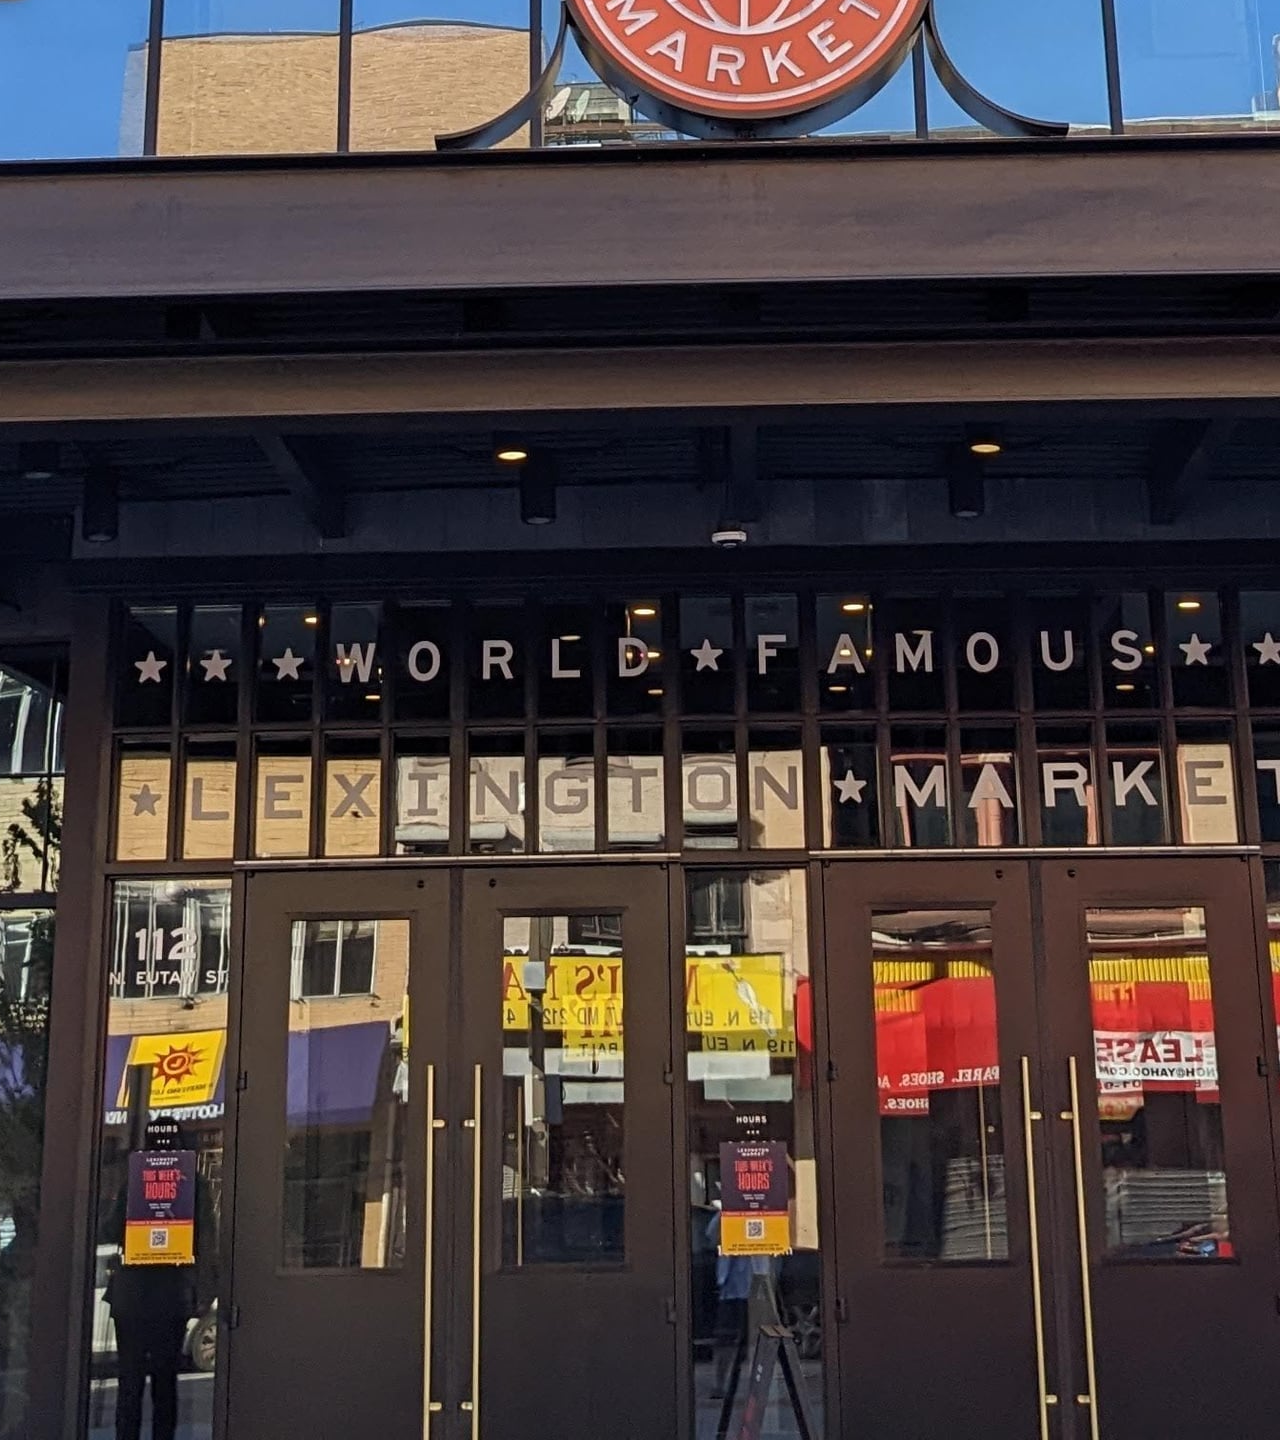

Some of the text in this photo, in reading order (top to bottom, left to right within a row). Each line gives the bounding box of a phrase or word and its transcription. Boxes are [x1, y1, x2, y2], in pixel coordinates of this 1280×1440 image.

[336, 630, 1143, 684] WORLD FAMOUS
[191, 764, 798, 821] LEXINGTON
[135, 927, 197, 960] 112
[109, 971, 126, 985] N.
[136, 970, 197, 985] EUTAW
[736, 1115, 767, 1124] HOURS
[147, 1125, 178, 1133] HOURS
[738, 1171, 770, 1191] HOURS
[145, 1182, 177, 1199] HOURS
